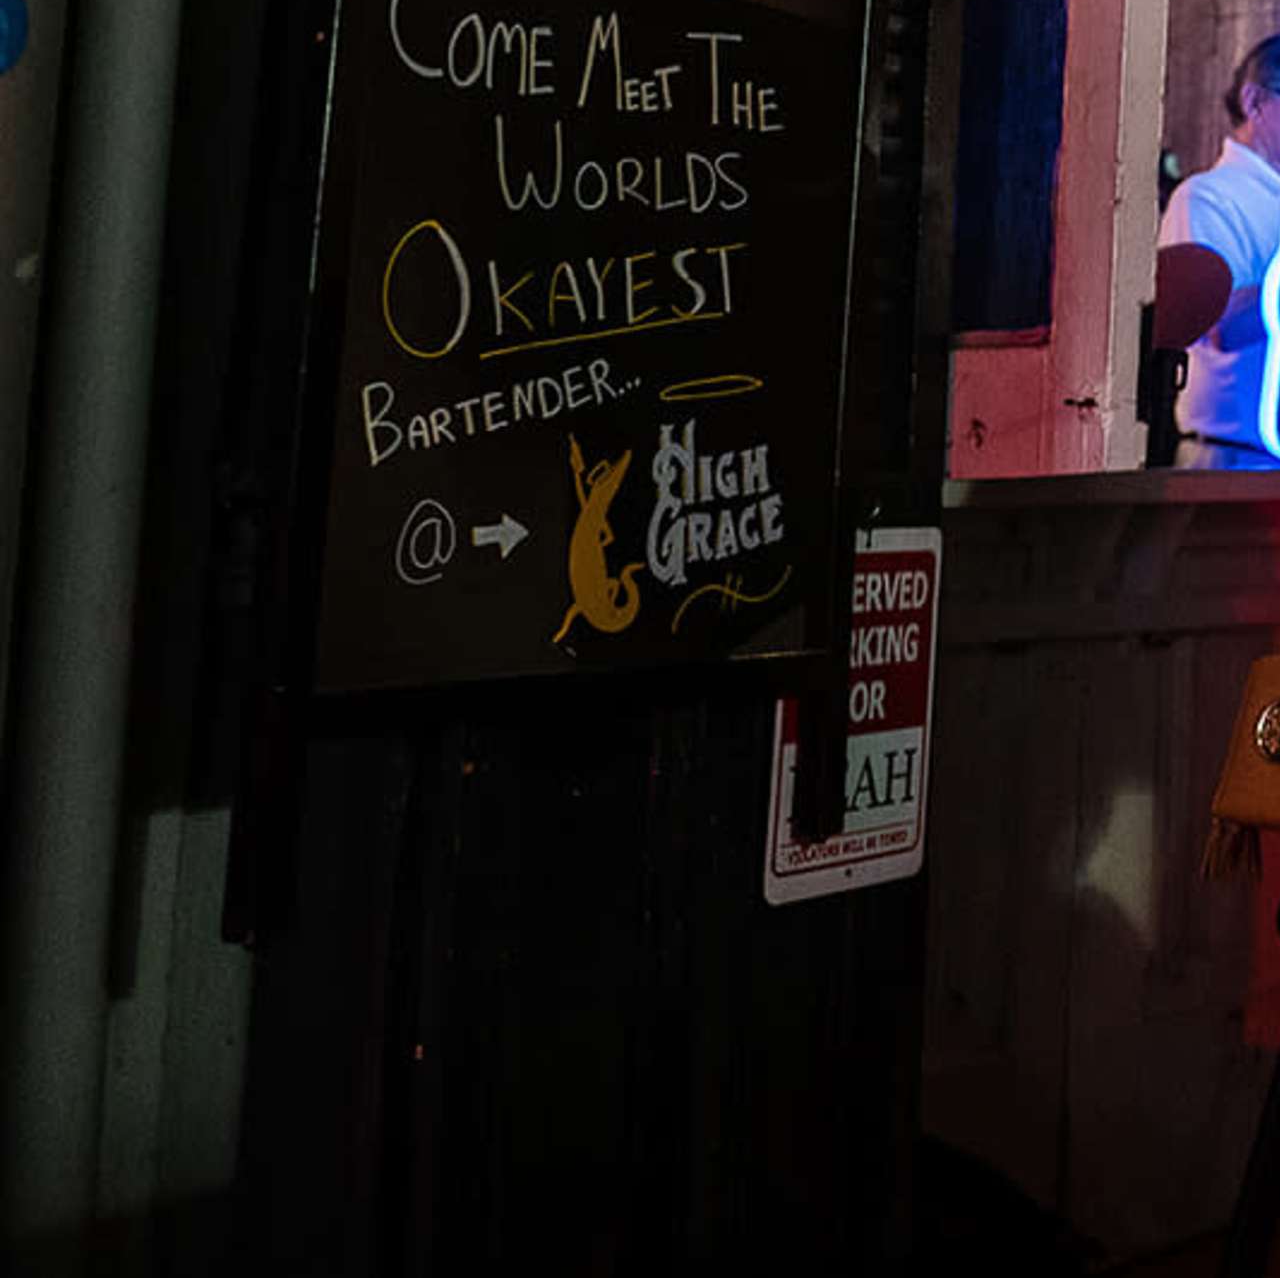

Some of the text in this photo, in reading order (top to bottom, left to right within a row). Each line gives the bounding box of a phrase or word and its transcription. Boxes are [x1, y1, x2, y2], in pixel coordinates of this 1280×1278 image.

[576, 9, 684, 114] MEET
[685, 30, 787, 135] THE
[494, 113, 751, 214] WORLDS
[381, 218, 751, 360] OKAYEST
[650, 417, 770, 507] HIGH
[395, 497, 457, 586] @
[645, 494, 785, 588] GRACE
[853, 570, 929, 614] ERVED
[849, 621, 921, 669] KING
[849, 679, 887, 723] OR
[847, 746, 918, 813] AH
